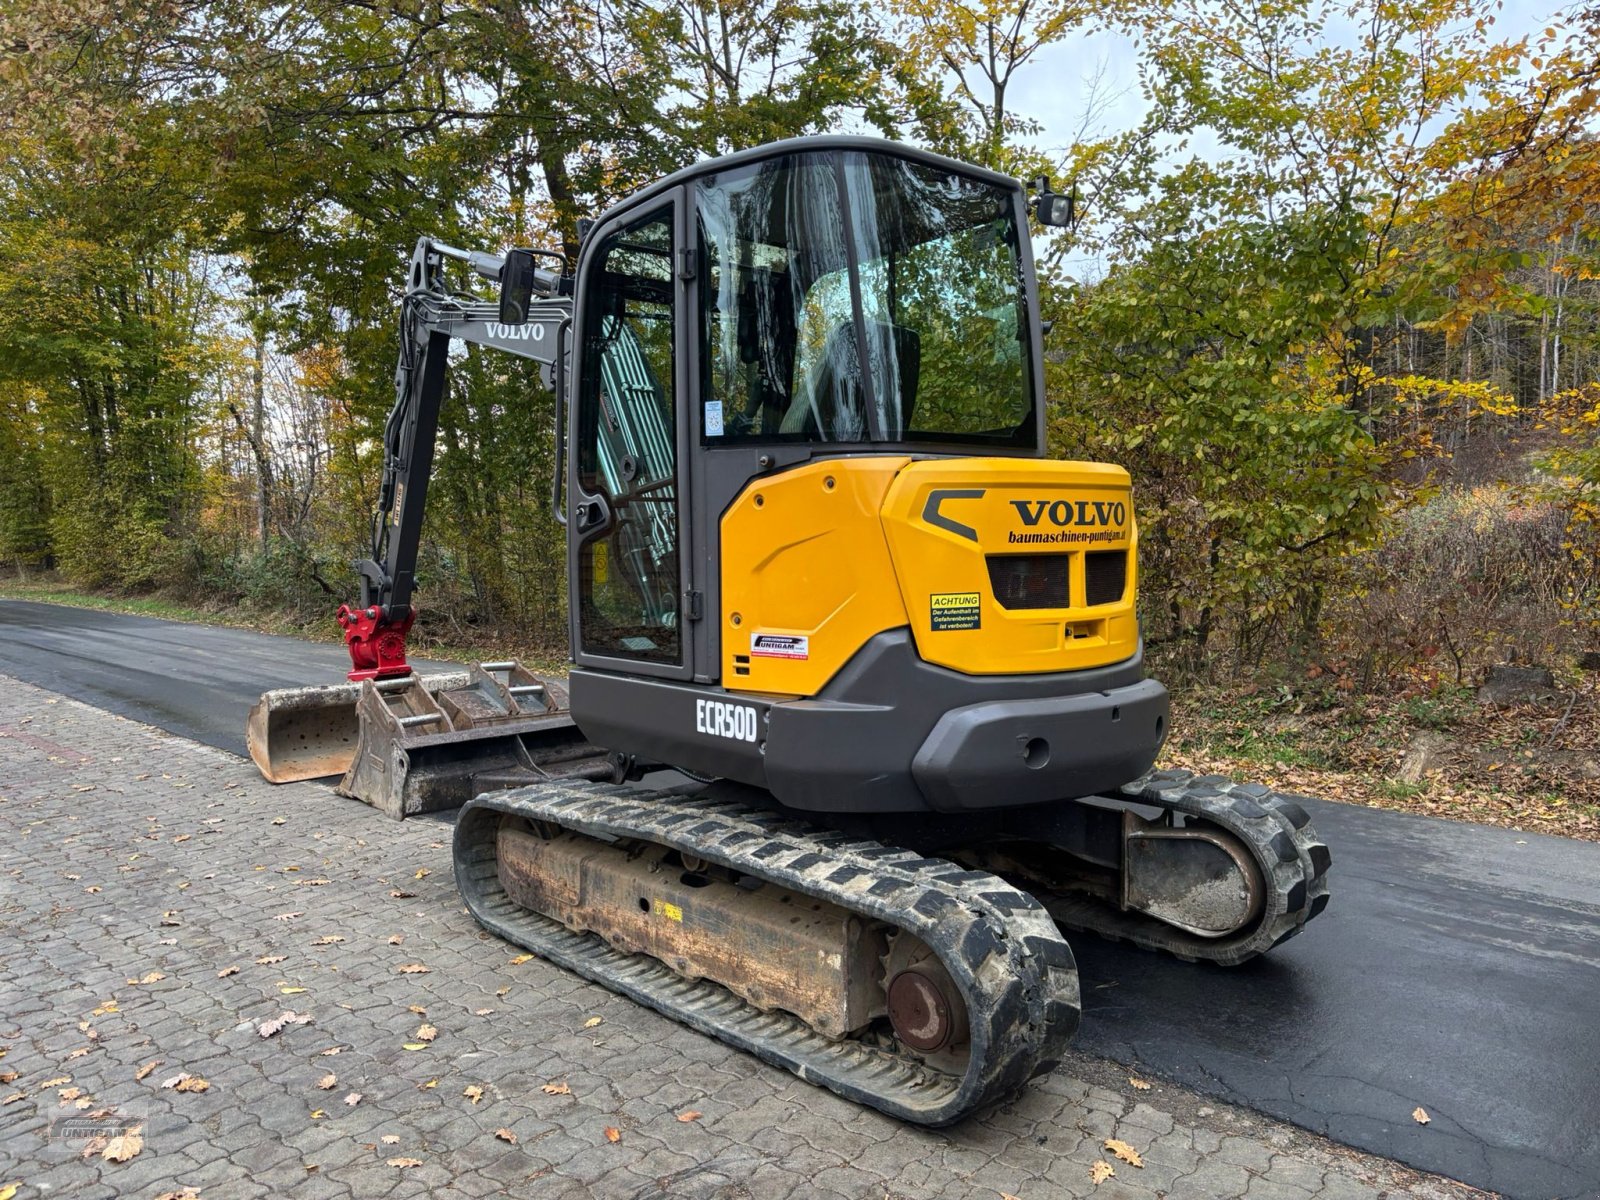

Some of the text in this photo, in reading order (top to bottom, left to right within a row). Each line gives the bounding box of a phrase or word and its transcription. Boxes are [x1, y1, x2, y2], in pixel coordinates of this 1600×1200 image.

[484, 321, 545, 341] VOLVO
[1009, 500, 1126, 527] VOLVO
[934, 596, 977, 605] ACHTUNG
[696, 699, 757, 743] ECR50D
